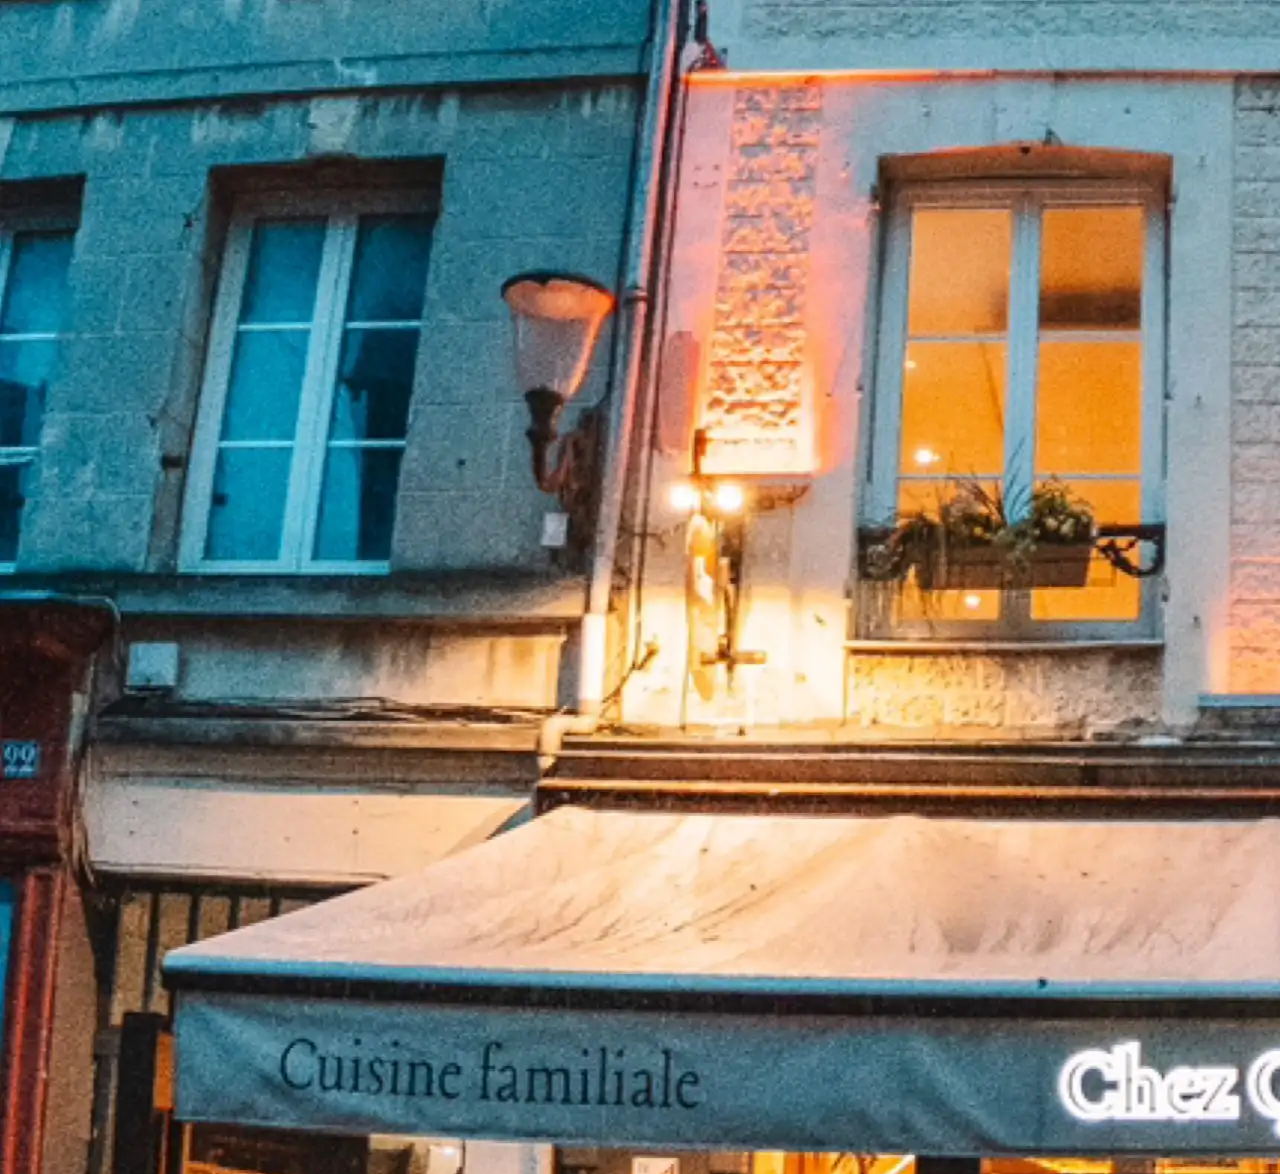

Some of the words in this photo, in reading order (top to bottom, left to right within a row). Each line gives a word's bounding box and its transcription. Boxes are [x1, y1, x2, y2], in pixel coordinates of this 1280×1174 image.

[279, 1038, 462, 1100] Cuisine
[479, 1041, 700, 1109] familiale
[1058, 1040, 1240, 1121] Chez
